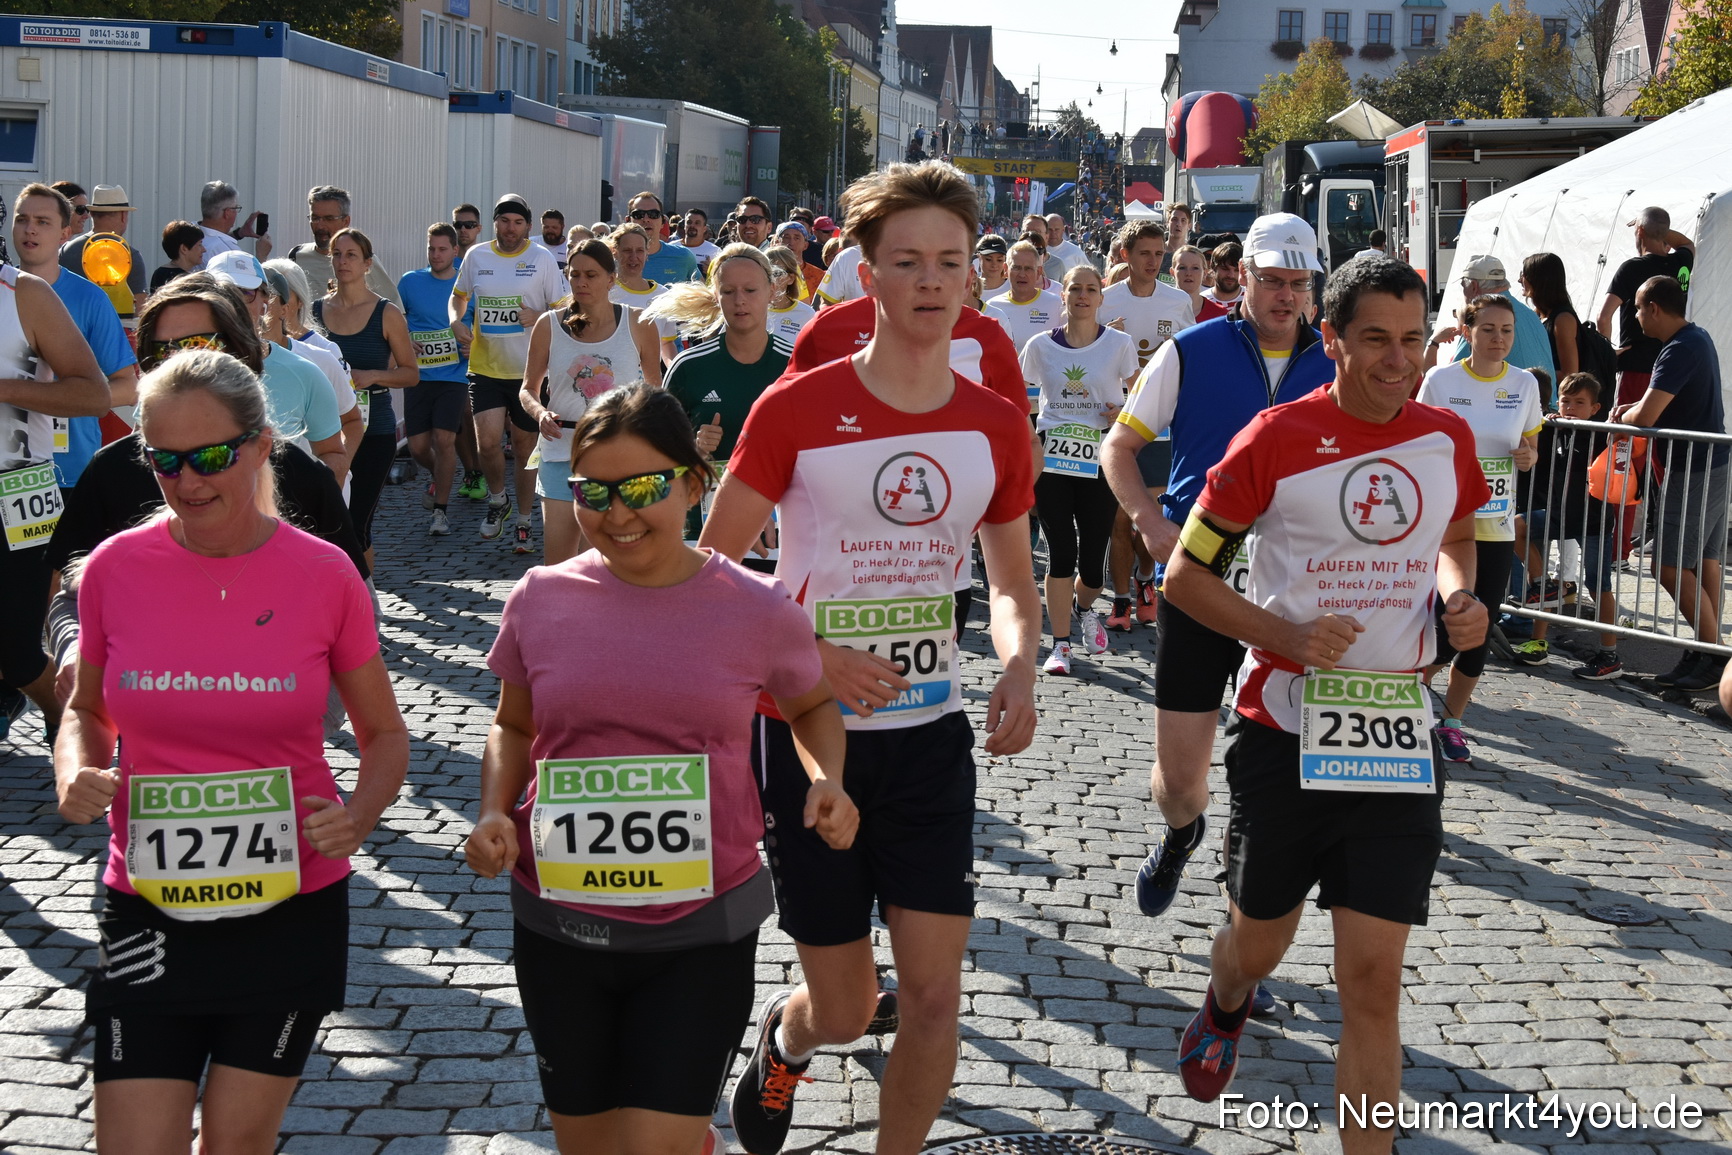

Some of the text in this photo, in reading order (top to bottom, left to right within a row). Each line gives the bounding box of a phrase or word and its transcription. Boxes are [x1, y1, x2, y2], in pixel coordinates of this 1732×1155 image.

[25, 27, 39, 35] TOI
[40, 28, 54, 36] TOI
[62, 28, 80, 36] DIXI
[130, 31, 140, 39] 80
[88, 38, 141, 46] www.toitoidixi.de
[994, 162, 1036, 174] START
[481, 298, 518, 307] BOCK
[483, 310, 518, 323] 2740
[414, 332, 450, 341] BOCK
[422, 356, 451, 364] FLORIAN
[1052, 425, 1096, 440] BOCK
[1048, 438, 1094, 460] 2420
[1316, 446, 1340, 454] erima
[1056, 460, 1080, 470] ANJA
[1478, 459, 1508, 472] CK
[12, 489, 60, 520] 1054
[841, 540, 955, 556] LAUFEN MIT HER
[854, 560, 867, 568] Dr.
[870, 558, 892, 567] Heck
[902, 558, 916, 568] Dr.
[1306, 558, 1428, 573] LAUFEN MIT HRZ
[853, 572, 939, 584] Leistungsdiagnostik
[1318, 580, 1334, 590] Dr.
[1338, 580, 1364, 589] Heck
[1368, 580, 1373, 590] /
[1376, 581, 1390, 590] Dr.
[1318, 597, 1412, 610] Leistungsdignostik
[826, 601, 944, 633] BOCK
[118, 670, 296, 692] Mädchenband
[1314, 674, 1417, 705] BOCK
[1319, 711, 1417, 750] 2308
[1314, 760, 1421, 778] JOHANNES
[550, 762, 694, 799] BOCK
[140, 775, 280, 814] BOCK
[281, 824, 288, 832] D
[554, 810, 690, 854] 1266
[146, 822, 278, 870] 1274
[582, 870, 663, 888] AIGUL
[161, 880, 263, 903] MARION
[557, 916, 610, 938] FORM
[273, 1018, 294, 1058] FUSION
